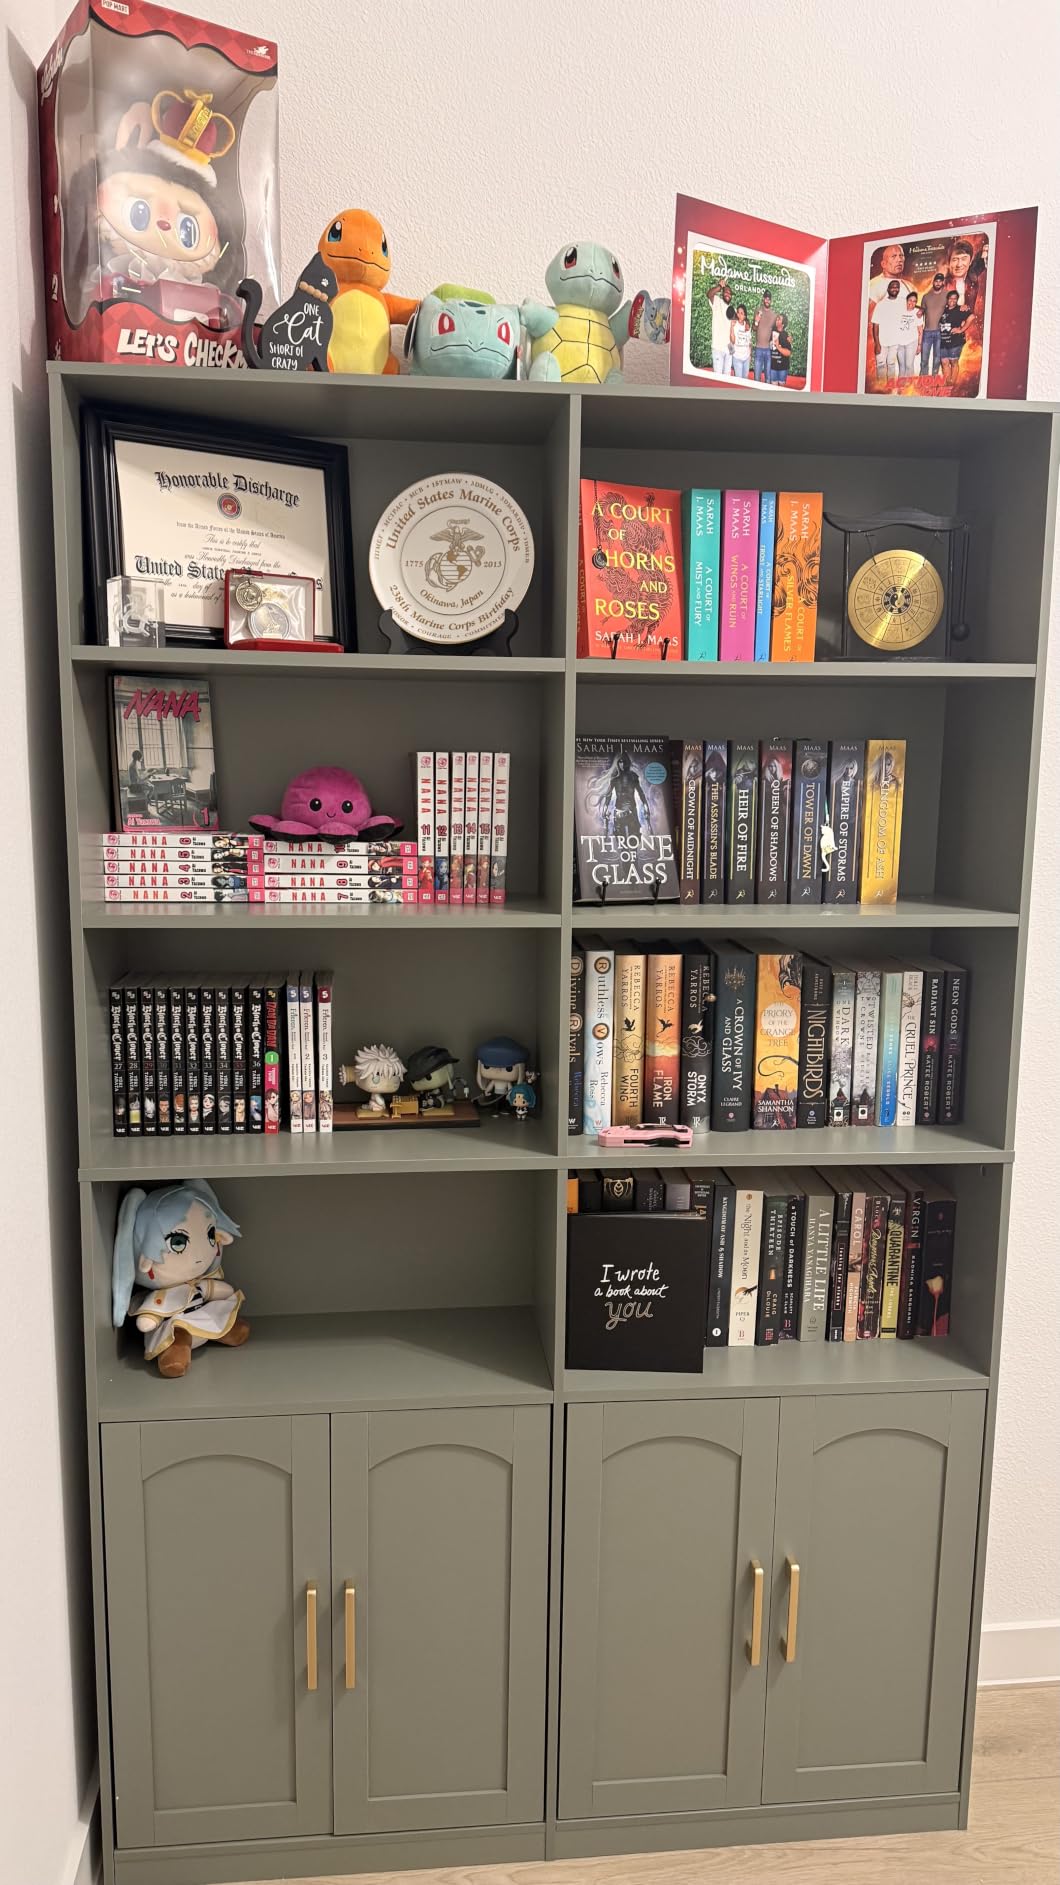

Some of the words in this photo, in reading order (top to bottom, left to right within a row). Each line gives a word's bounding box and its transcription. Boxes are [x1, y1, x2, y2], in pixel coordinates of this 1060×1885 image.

[102, 0, 113, 8] POP
[700, 256, 751, 281] Madame
[748, 264, 796, 288] Tussauds
[735, 285, 766, 295] ORLANDO
[304, 303, 320, 316] ONE
[117, 328, 178, 360] LET'S
[273, 311, 323, 346] Cat
[270, 342, 294, 356] SHORT
[272, 356, 298, 371] CRAZY
[154, 472, 229, 493] Honorable
[233, 474, 300, 508] Discharge
[386, 504, 416, 549] United
[418, 490, 455, 510] States
[460, 488, 503, 517] Marine
[502, 516, 521, 553] Corps
[592, 502, 604, 518] A
[610, 502, 673, 525] COURT
[696, 506, 704, 537] MAAS
[706, 498, 715, 535] SARAH
[608, 528, 627, 541] OF
[134, 554, 183, 577] United
[187, 561, 226, 582] State
[404, 560, 424, 568] 1775
[484, 560, 503, 568] 2013
[592, 548, 676, 574] HORNS
[420, 588, 459, 609] Okinawa,
[460, 590, 484, 609] Japan
[640, 580, 668, 594] AND
[704, 577, 713, 613] COURT
[786, 576, 795, 610] SILVER
[390, 584, 410, 613] 238th
[410, 611, 445, 630] Marine
[448, 620, 476, 632] Corps
[478, 587, 515, 623] Birthday
[594, 598, 661, 621] ROSES
[694, 600, 703, 627] FURY
[784, 612, 793, 652] FLAMES
[796, 607, 805, 641] COURT
[124, 688, 202, 722] NANA
[577, 743, 614, 754] SARAH
[633, 744, 665, 753] MAAS
[436, 779, 447, 815] NANA
[688, 780, 697, 817] CROWN
[711, 782, 720, 801] THE
[738, 789, 750, 821] HEIR
[771, 780, 781, 815] QUEEN
[804, 782, 816, 825] TOWER
[840, 780, 851, 821] EMPIRE
[202, 808, 210, 825] 1
[436, 824, 448, 837] 12
[688, 818, 695, 830] OF
[710, 802, 719, 850] ASSASSIN'S
[770, 816, 779, 830] OF
[839, 822, 849, 837] OF
[131, 836, 168, 846] NANA
[180, 838, 192, 846] 6
[738, 824, 749, 841] OF
[803, 828, 814, 840] OF
[291, 858, 326, 869] NANA
[580, 834, 675, 863] THRONE
[620, 851, 638, 863] OF
[686, 832, 695, 881] MIDNIGHT
[736, 844, 748, 873] FIRE
[768, 831, 779, 883] SHADOWS
[802, 842, 813, 880] DAWN
[836, 838, 848, 883] STORMS
[592, 862, 668, 886] GLASS
[710, 852, 718, 881] BLADE
[594, 956, 612, 1020] Ruthless
[632, 965, 641, 1011] REBECCA
[930, 978, 939, 1018] RADIANT
[952, 978, 960, 1006] NEON
[724, 1016, 732, 1035] AND
[763, 1010, 794, 1018] PRIORY
[840, 1008, 851, 1048] DARK
[866, 1000, 877, 1050] TWISTED
[950, 1008, 959, 1035] GODS
[592, 1022, 610, 1066] Vows
[733, 1008, 745, 1057] CROWN
[904, 1022, 917, 1059] CRUEL
[721, 1037, 733, 1074] GLASS
[735, 1058, 743, 1070] OF
[803, 1010, 826, 1099] NIGHTBIRDS
[620, 1076, 629, 1102] WING
[630, 1068, 639, 1108] FOURTH
[652, 1070, 664, 1108] FLAME
[664, 1076, 673, 1102] IRON
[686, 1072, 698, 1107] STORM
[698, 1074, 707, 1103] ONYX
[732, 1072, 743, 1092] IVY
[903, 1059, 917, 1101] PRINCE
[740, 1214, 753, 1237] Night
[820, 1208, 831, 1217] A
[853, 1208, 863, 1246] CAROL
[912, 1198, 921, 1239] VIRGIN
[768, 1210, 776, 1256] THIRTEEN
[776, 1214, 784, 1251] EPISODE
[816, 1223, 831, 1275] LITTLE
[886, 1230, 903, 1287] QUARANTINE
[600, 1264, 615, 1283] I
[614, 1262, 661, 1281] wrote
[740, 1257, 750, 1280] Moon
[786, 1248, 795, 1288] DARKNESS
[594, 1286, 603, 1298] a
[606, 1284, 633, 1299] book
[634, 1284, 670, 1299] about
[814, 1279, 827, 1312] LIFE
[604, 1300, 654, 1331] you
